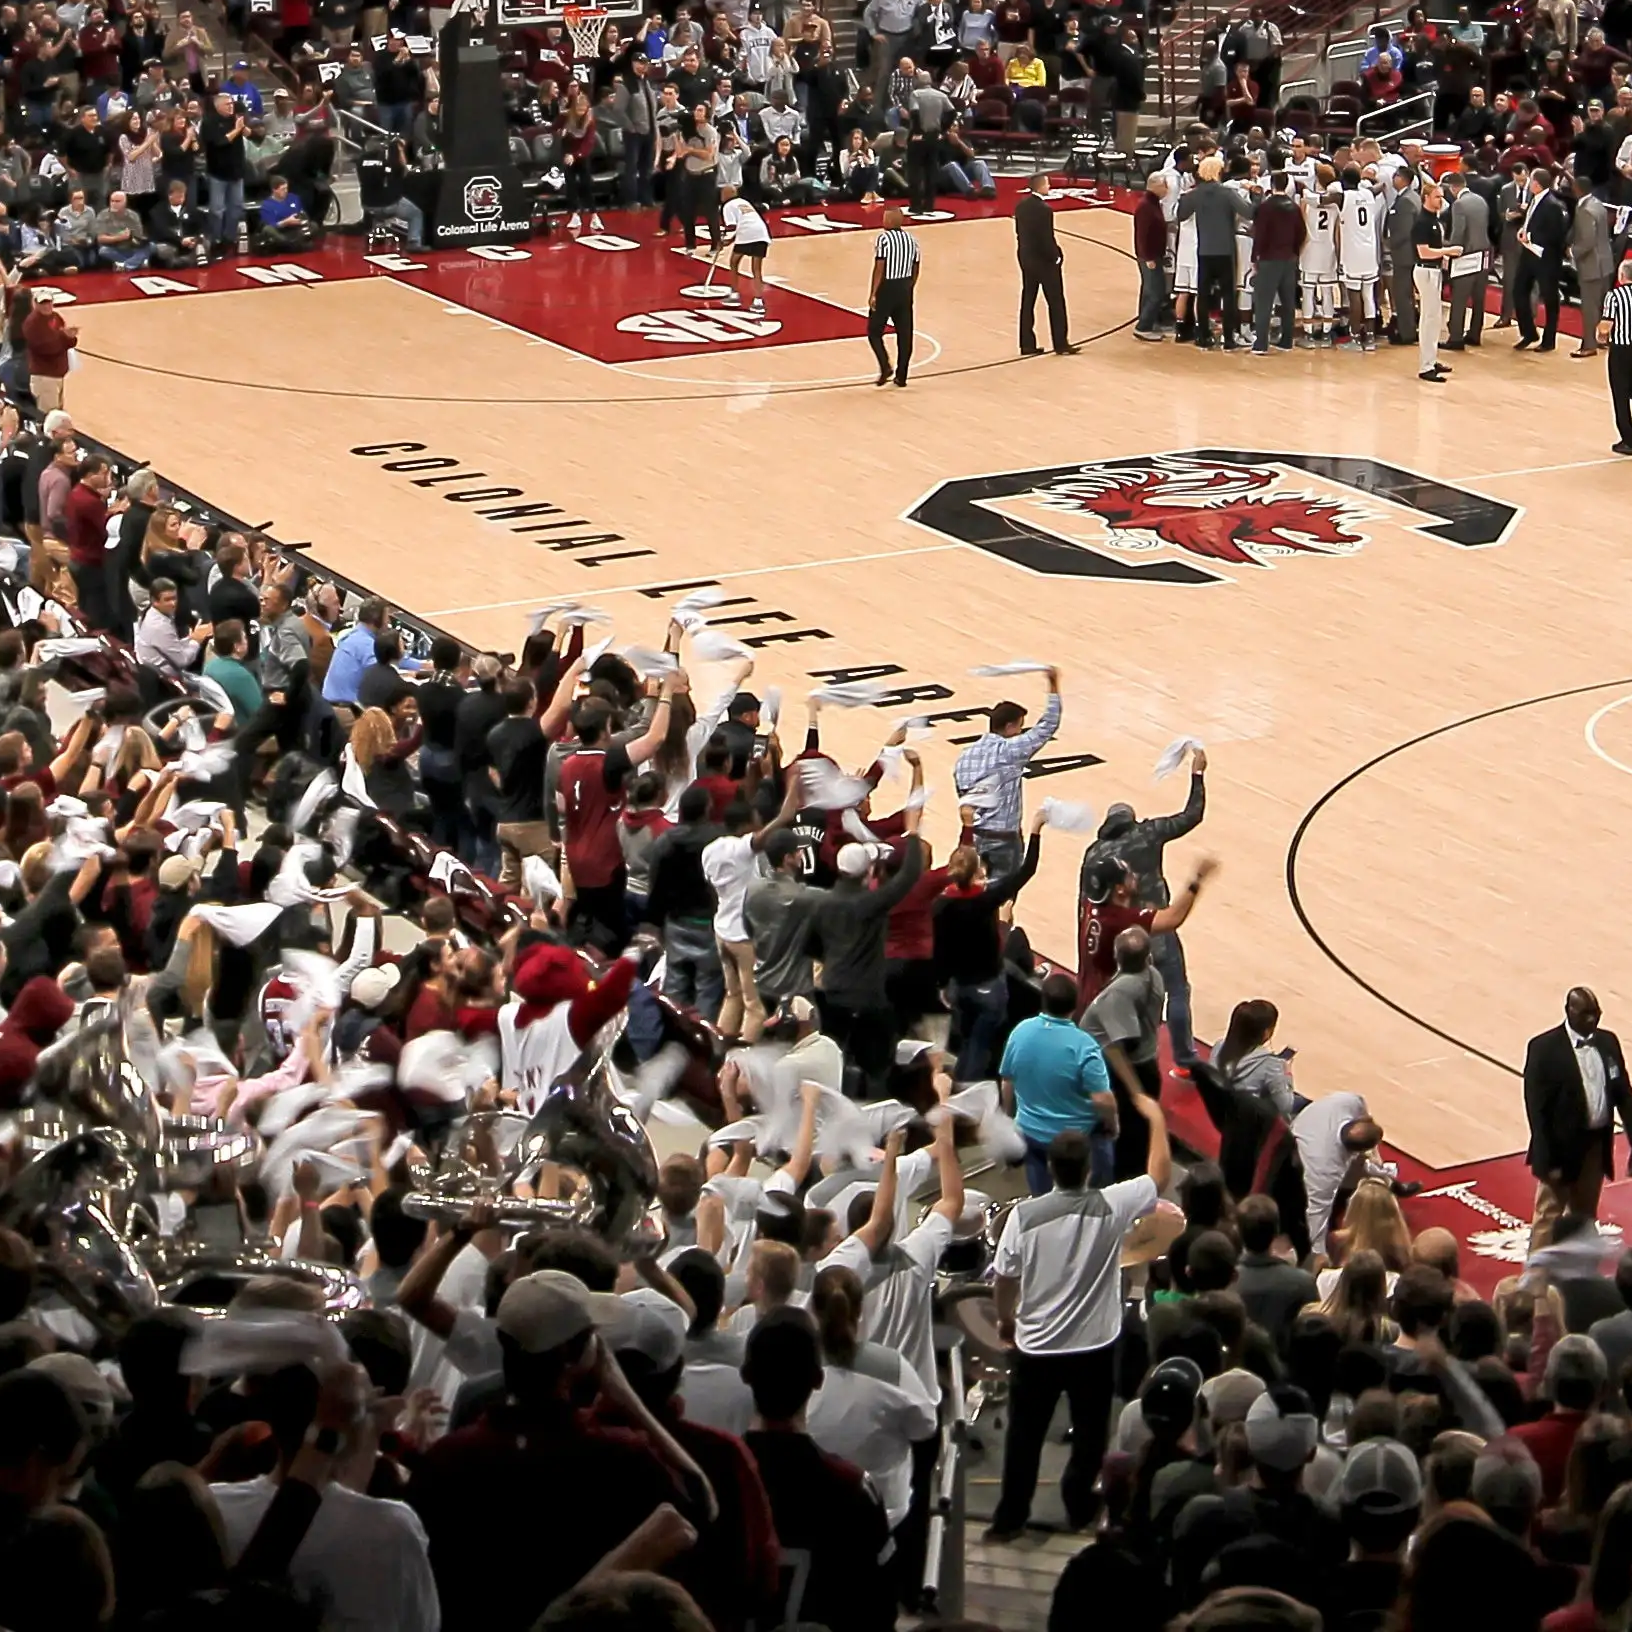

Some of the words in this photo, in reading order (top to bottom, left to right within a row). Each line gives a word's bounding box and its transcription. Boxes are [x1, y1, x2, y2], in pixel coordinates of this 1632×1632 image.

[1318, 210, 1328, 230] 2
[1358, 207, 1367, 226] 0
[437, 222, 479, 236] Colonial
[481, 221, 497, 234] Life
[498, 219, 529, 232] Arena
[350, 440, 657, 567] COLONIAL
